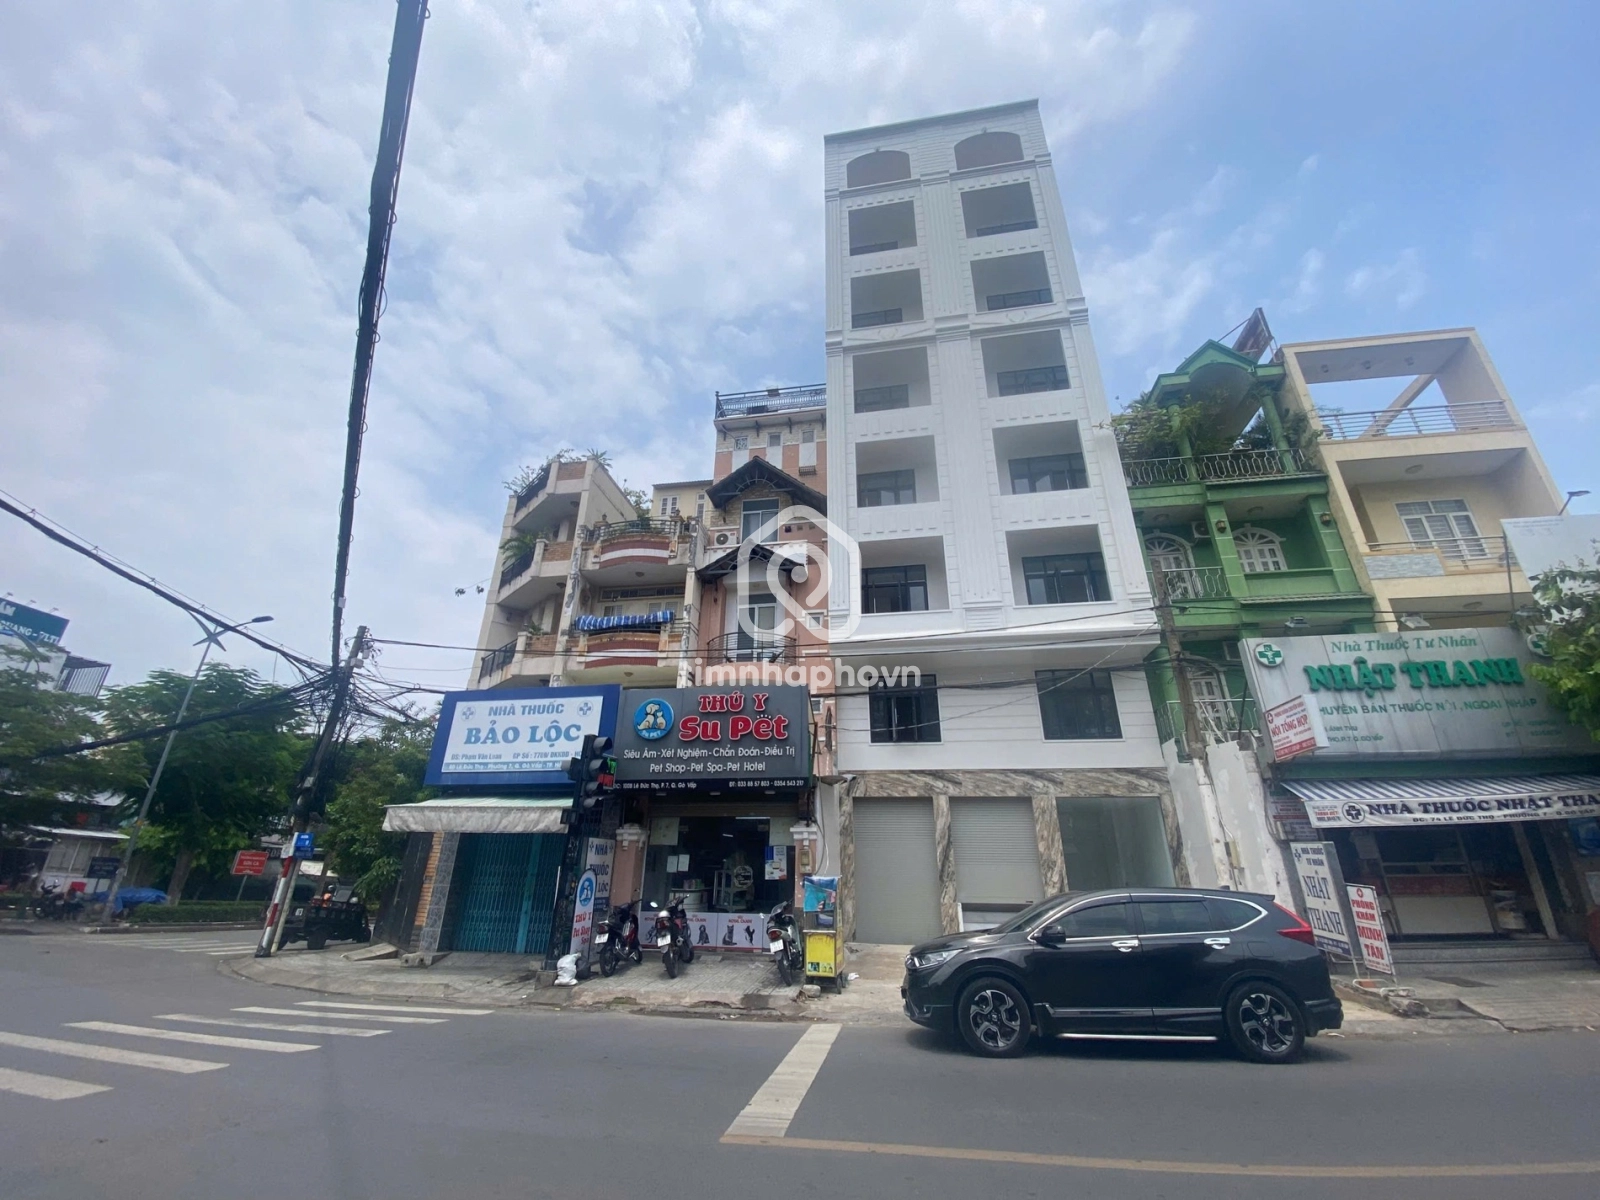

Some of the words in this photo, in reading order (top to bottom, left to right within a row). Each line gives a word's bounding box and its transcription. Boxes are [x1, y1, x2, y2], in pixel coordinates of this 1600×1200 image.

[1331, 640, 1361, 652] Nhà
[1365, 636, 1409, 651] Thuốc
[1413, 636, 1434, 649] Tư
[1438, 635, 1477, 648] Nhân
[1303, 656, 1397, 698] NHẬT
[1400, 657, 1525, 688] THANH
[487, 703, 516, 717] NHÀ
[521, 699, 565, 716] THUỐC
[698, 691, 745, 713] THÚ
[752, 693, 769, 712] Y
[1319, 703, 1358, 715] HUYÊN
[1362, 702, 1387, 714] BÁN
[1389, 697, 1433, 713] THUỐC
[463, 720, 520, 745] BẢO
[527, 720, 582, 748] LỘC
[679, 716, 722, 741] Su
[729, 714, 789, 740] Pet
[623, 749, 641, 759] Siêu
[786, 746, 795, 758] Trị
[650, 763, 663, 773] Pet
[743, 761, 766, 772] Hotel
[1367, 800, 1414, 815] NHÀ
[1418, 797, 1491, 813] THUỐC
[1497, 795, 1552, 811] NHẬT
[1557, 793, 1600, 807] THA
[1307, 907, 1345, 936] THANH
[1357, 925, 1384, 943] MINH
[1364, 942, 1385, 961] TÂN
